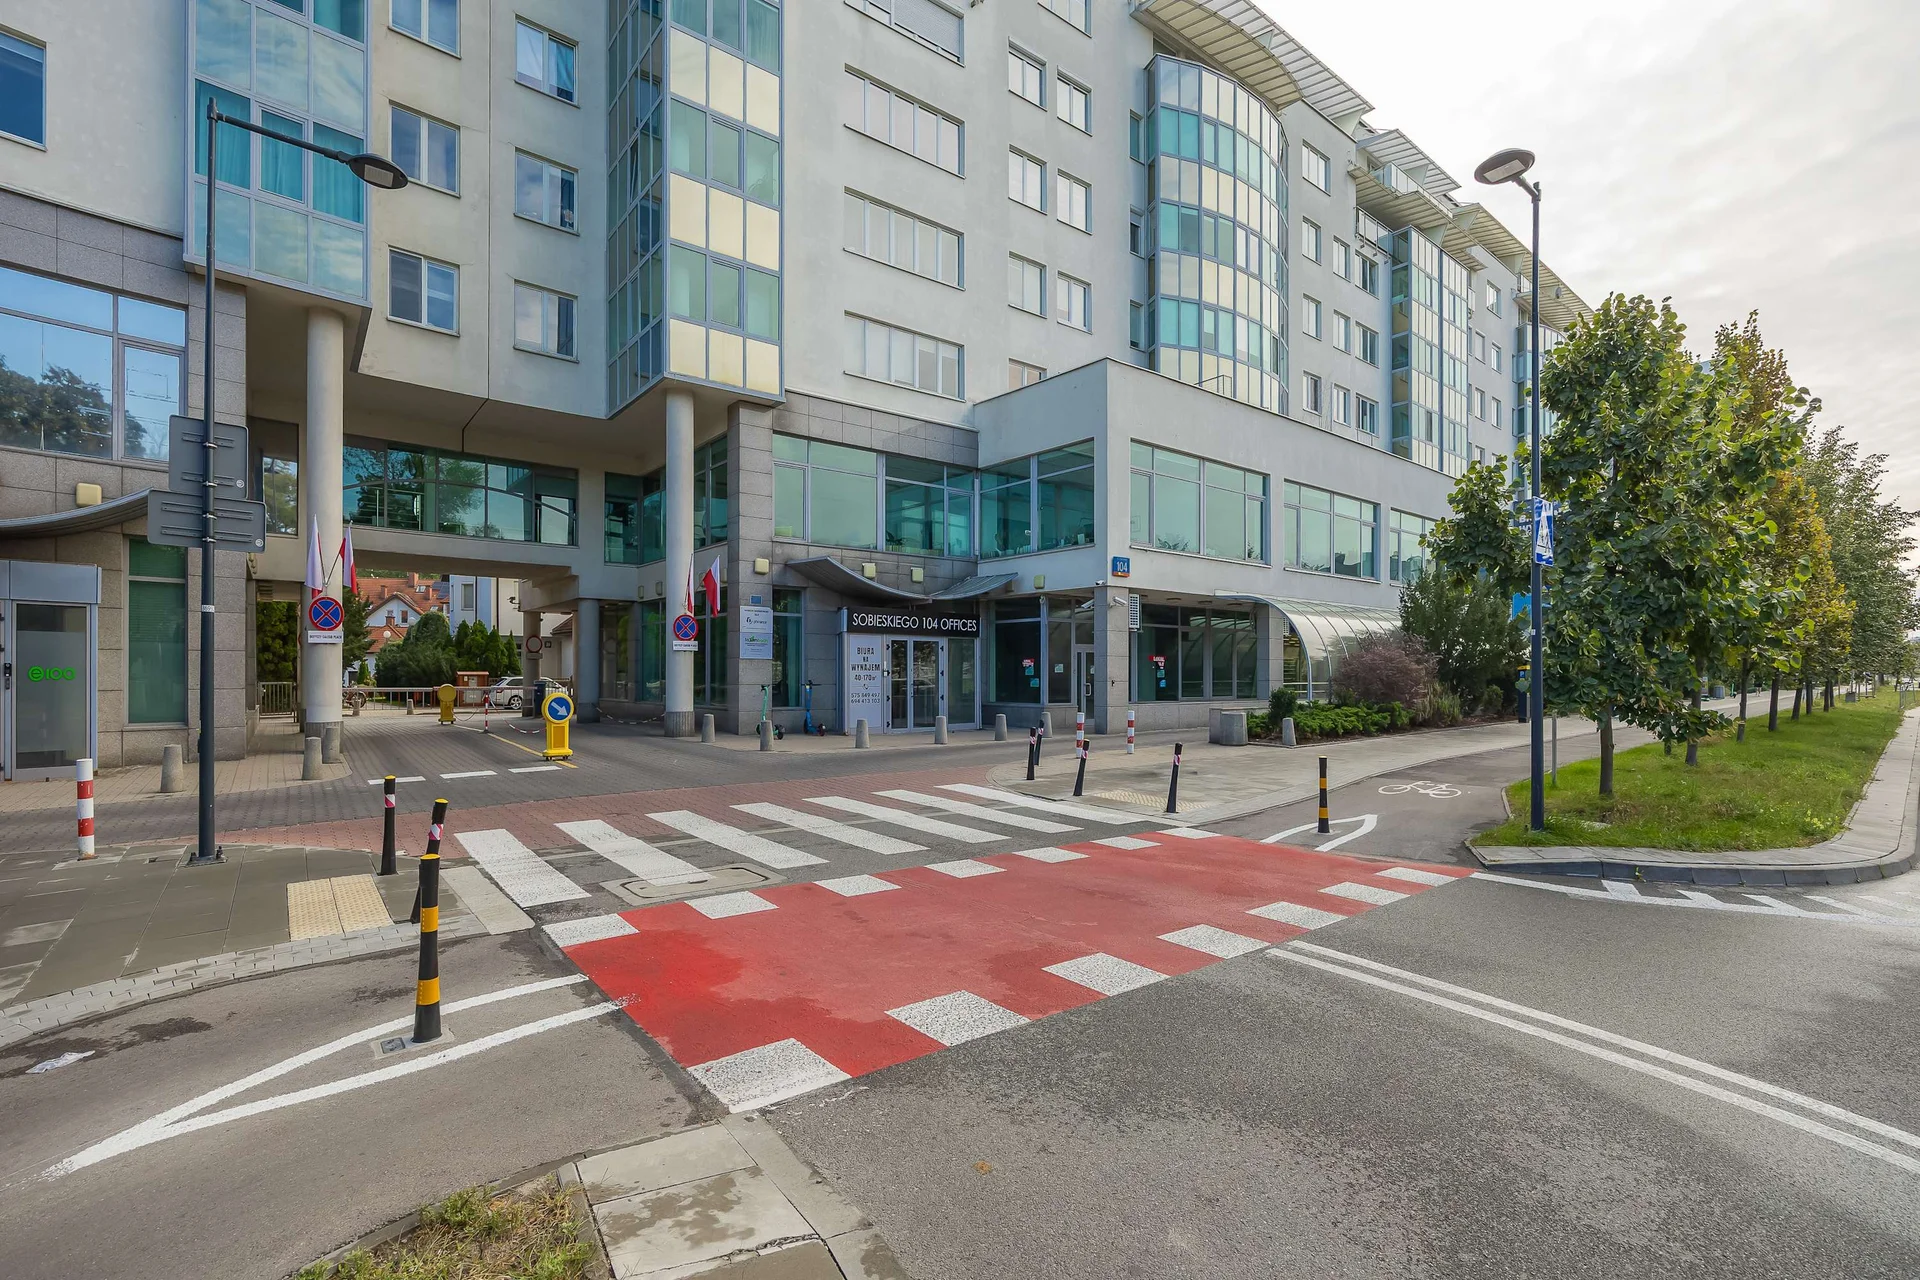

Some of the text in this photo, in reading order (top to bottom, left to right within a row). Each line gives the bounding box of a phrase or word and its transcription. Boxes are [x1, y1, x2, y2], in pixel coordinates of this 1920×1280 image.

[1117, 561, 1128, 572] 104
[852, 613, 977, 632] SOBIESKIEGO 104 OFFICES
[857, 647, 875, 655] BIURA
[851, 663, 880, 672] WYNAJEM
